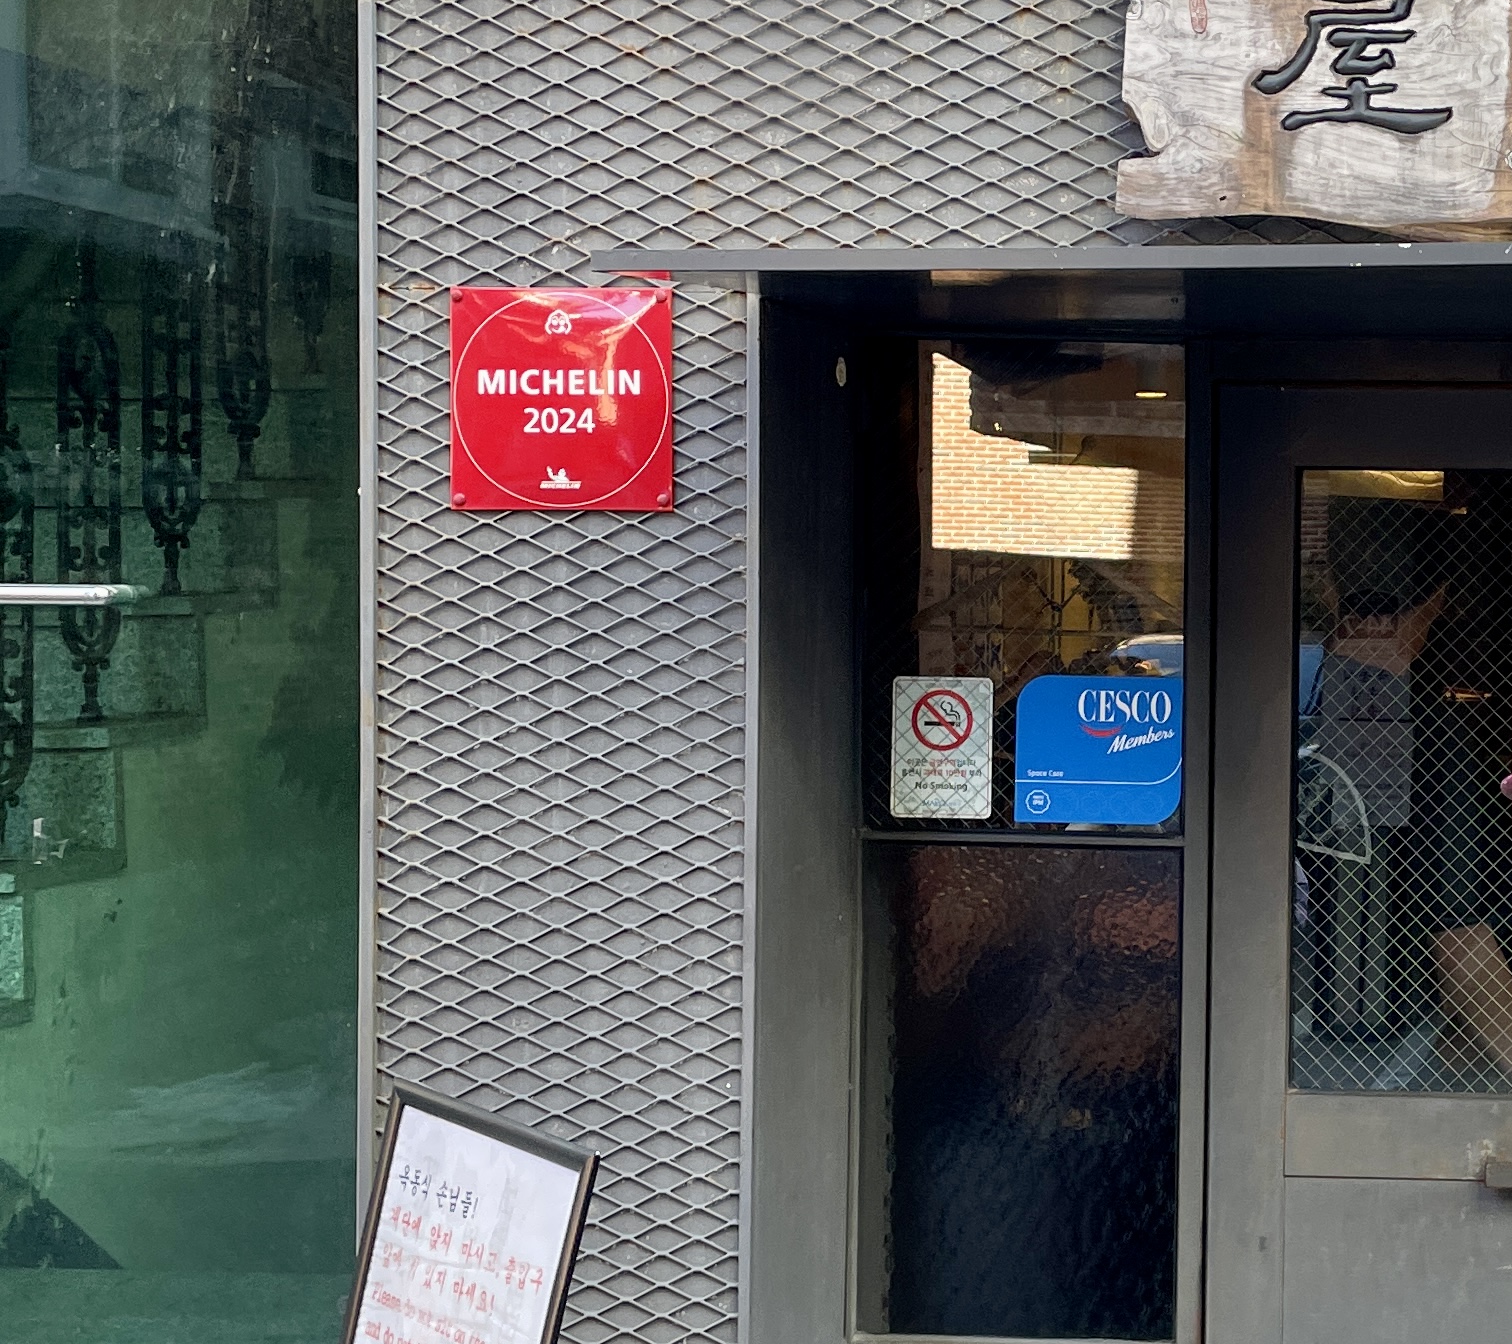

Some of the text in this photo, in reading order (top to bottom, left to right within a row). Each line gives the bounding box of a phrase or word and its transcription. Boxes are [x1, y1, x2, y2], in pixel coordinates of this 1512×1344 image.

[477, 369, 641, 396] MICHELIN
[523, 407, 596, 434] 2024
[1078, 689, 1172, 724] CESCO
[1107, 726, 1175, 755] Members
[914, 781, 968, 792] No Smoking
[399, 1165, 479, 1219] 옥동식 손님들!
[430, 1223, 452, 1256] 앉지
[504, 1256, 543, 1295] 출입구
[371, 1281, 401, 1312] Please
[418, 1309, 431, 1328] not
[434, 1317, 452, 1338] sit
[452, 1275, 495, 1317] 마세요!
[365, 1320, 381, 1340] and
